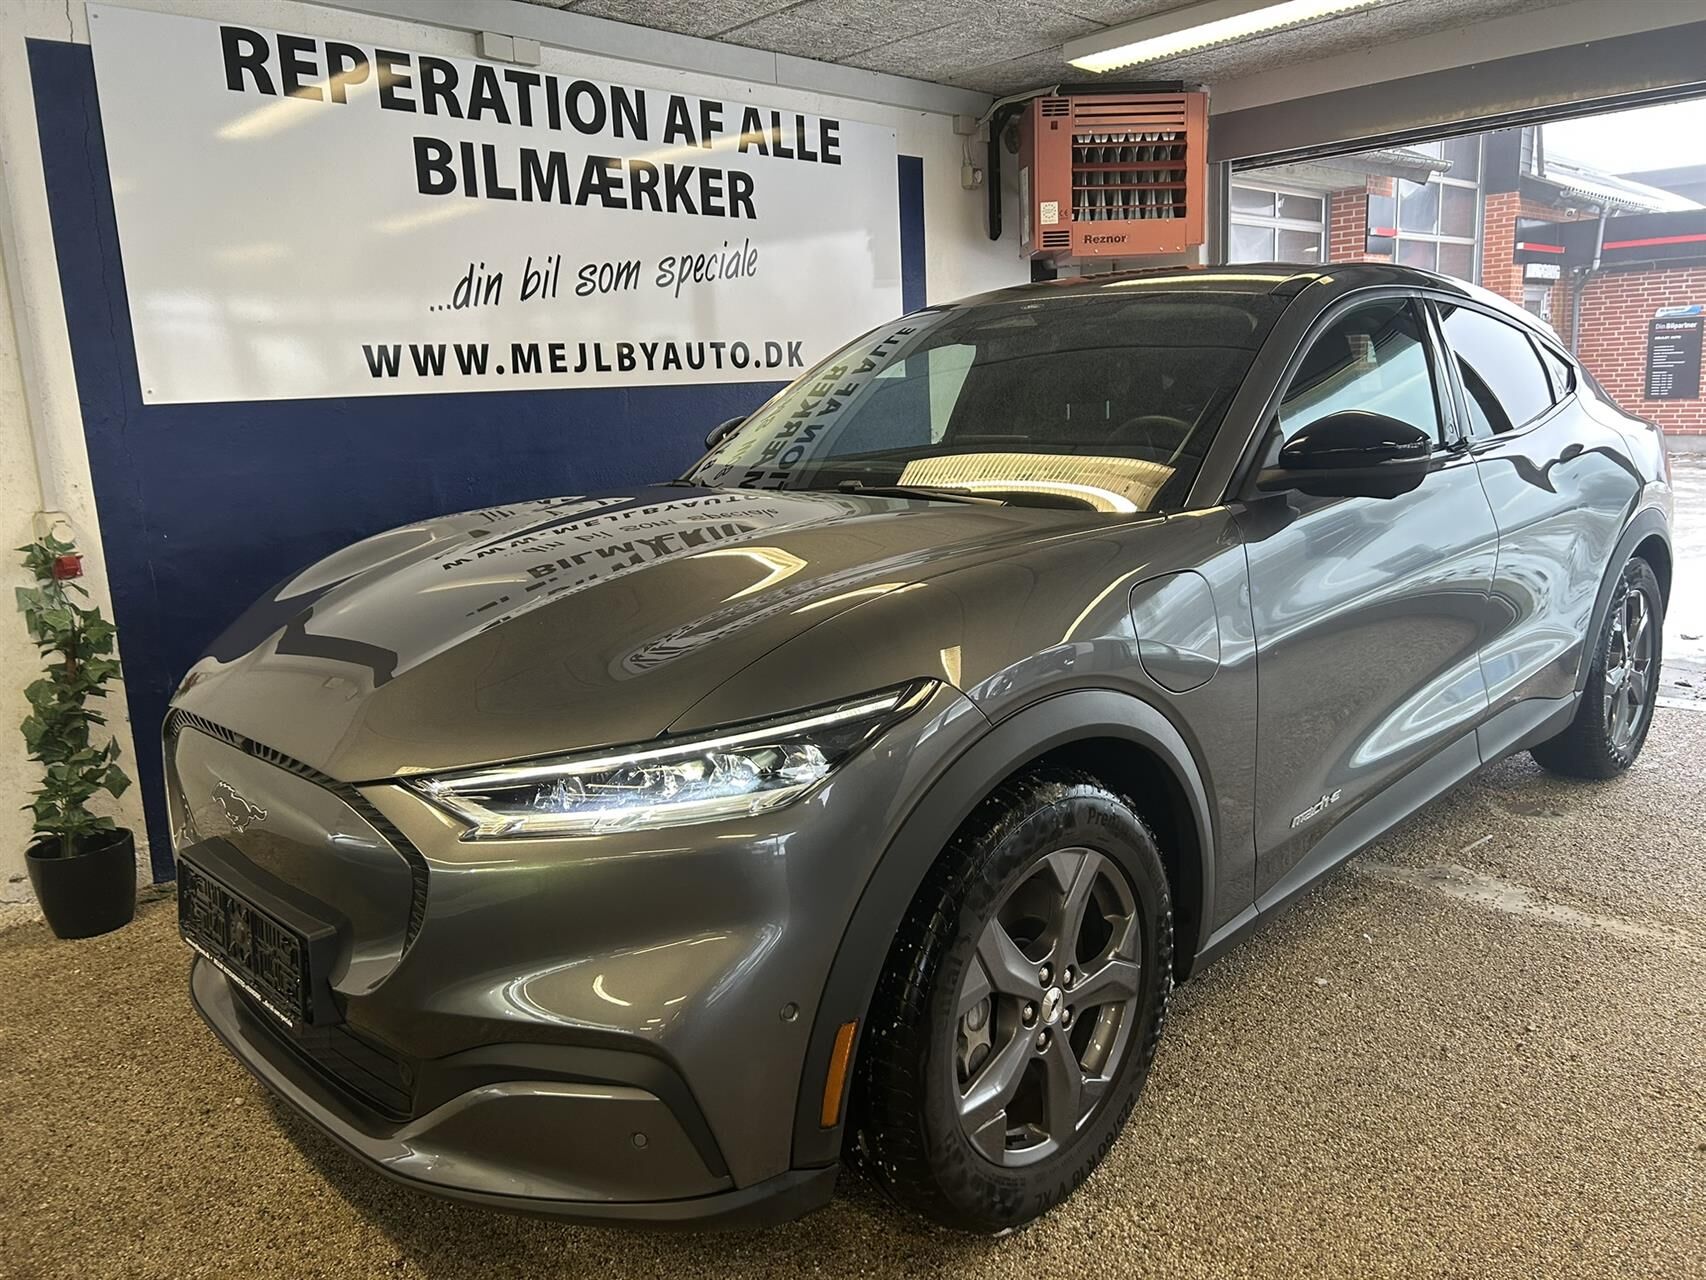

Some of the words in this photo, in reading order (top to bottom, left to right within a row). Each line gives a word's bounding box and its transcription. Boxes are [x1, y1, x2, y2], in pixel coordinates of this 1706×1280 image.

[221, 25, 648, 142] REPERATION
[664, 96, 723, 149] AF
[738, 107, 842, 166] ALLE
[413, 136, 757, 220] BILMÆRKER
[521, 254, 560, 302] bil
[576, 260, 641, 297] som
[657, 239, 758, 300] speciale
[1084, 234, 1127, 244] Reznor
[362, 341, 804, 379] WWW.MEJLBYAUTO.DK
